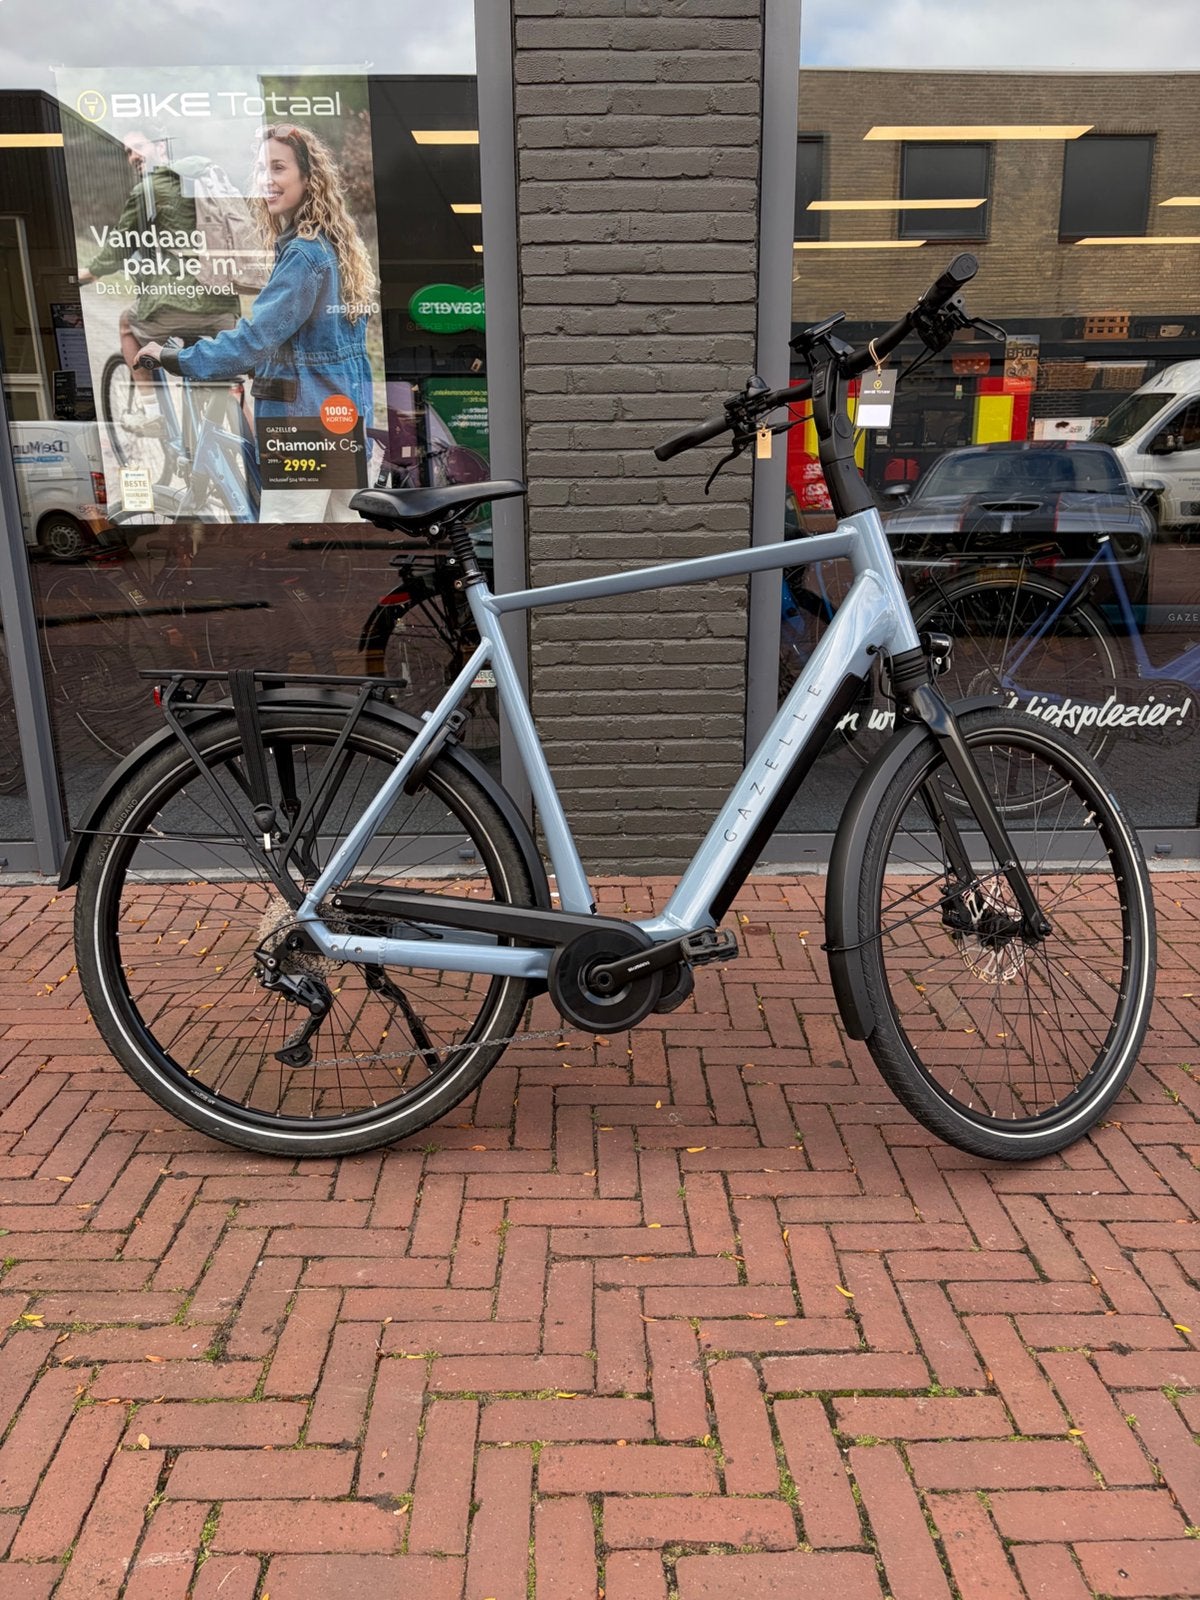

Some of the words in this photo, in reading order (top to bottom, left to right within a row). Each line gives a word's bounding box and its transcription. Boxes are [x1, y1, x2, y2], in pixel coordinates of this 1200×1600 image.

[111, 93, 210, 118] BIKE
[217, 91, 341, 117] Totaal
[90, 225, 207, 254] Vandaag
[123, 252, 172, 281] pak
[176, 252, 201, 281] je
[96, 282, 121, 295] Dat
[124, 282, 239, 298] vakantiegevoel.
[266, 439, 336, 452] Chamonix
[284, 459, 326, 471] 2999.-
[723, 684, 822, 842] GAZELLE
